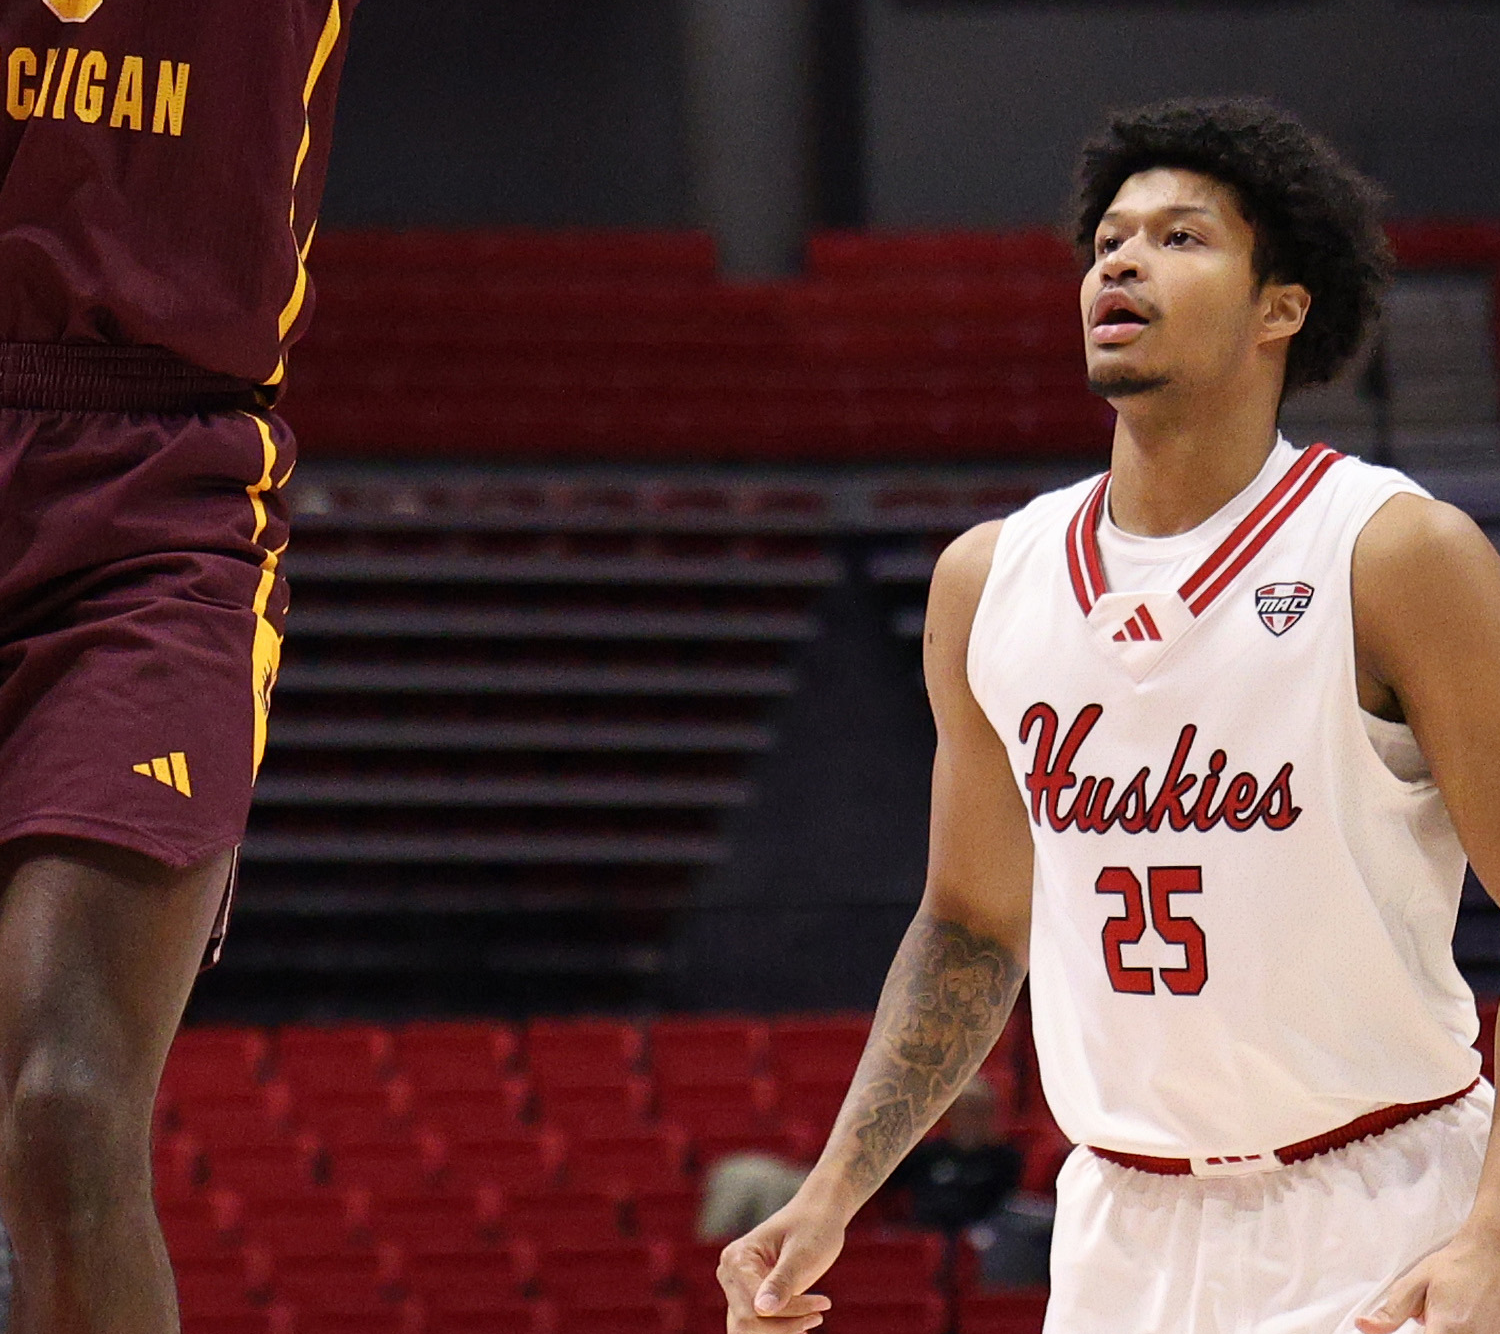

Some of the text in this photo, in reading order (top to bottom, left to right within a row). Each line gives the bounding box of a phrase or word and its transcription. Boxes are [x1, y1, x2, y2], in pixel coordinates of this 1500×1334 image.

[1257, 596, 1311, 612] MAC
[1018, 701, 1303, 835] Huskies
[1094, 865, 1209, 996] 25
